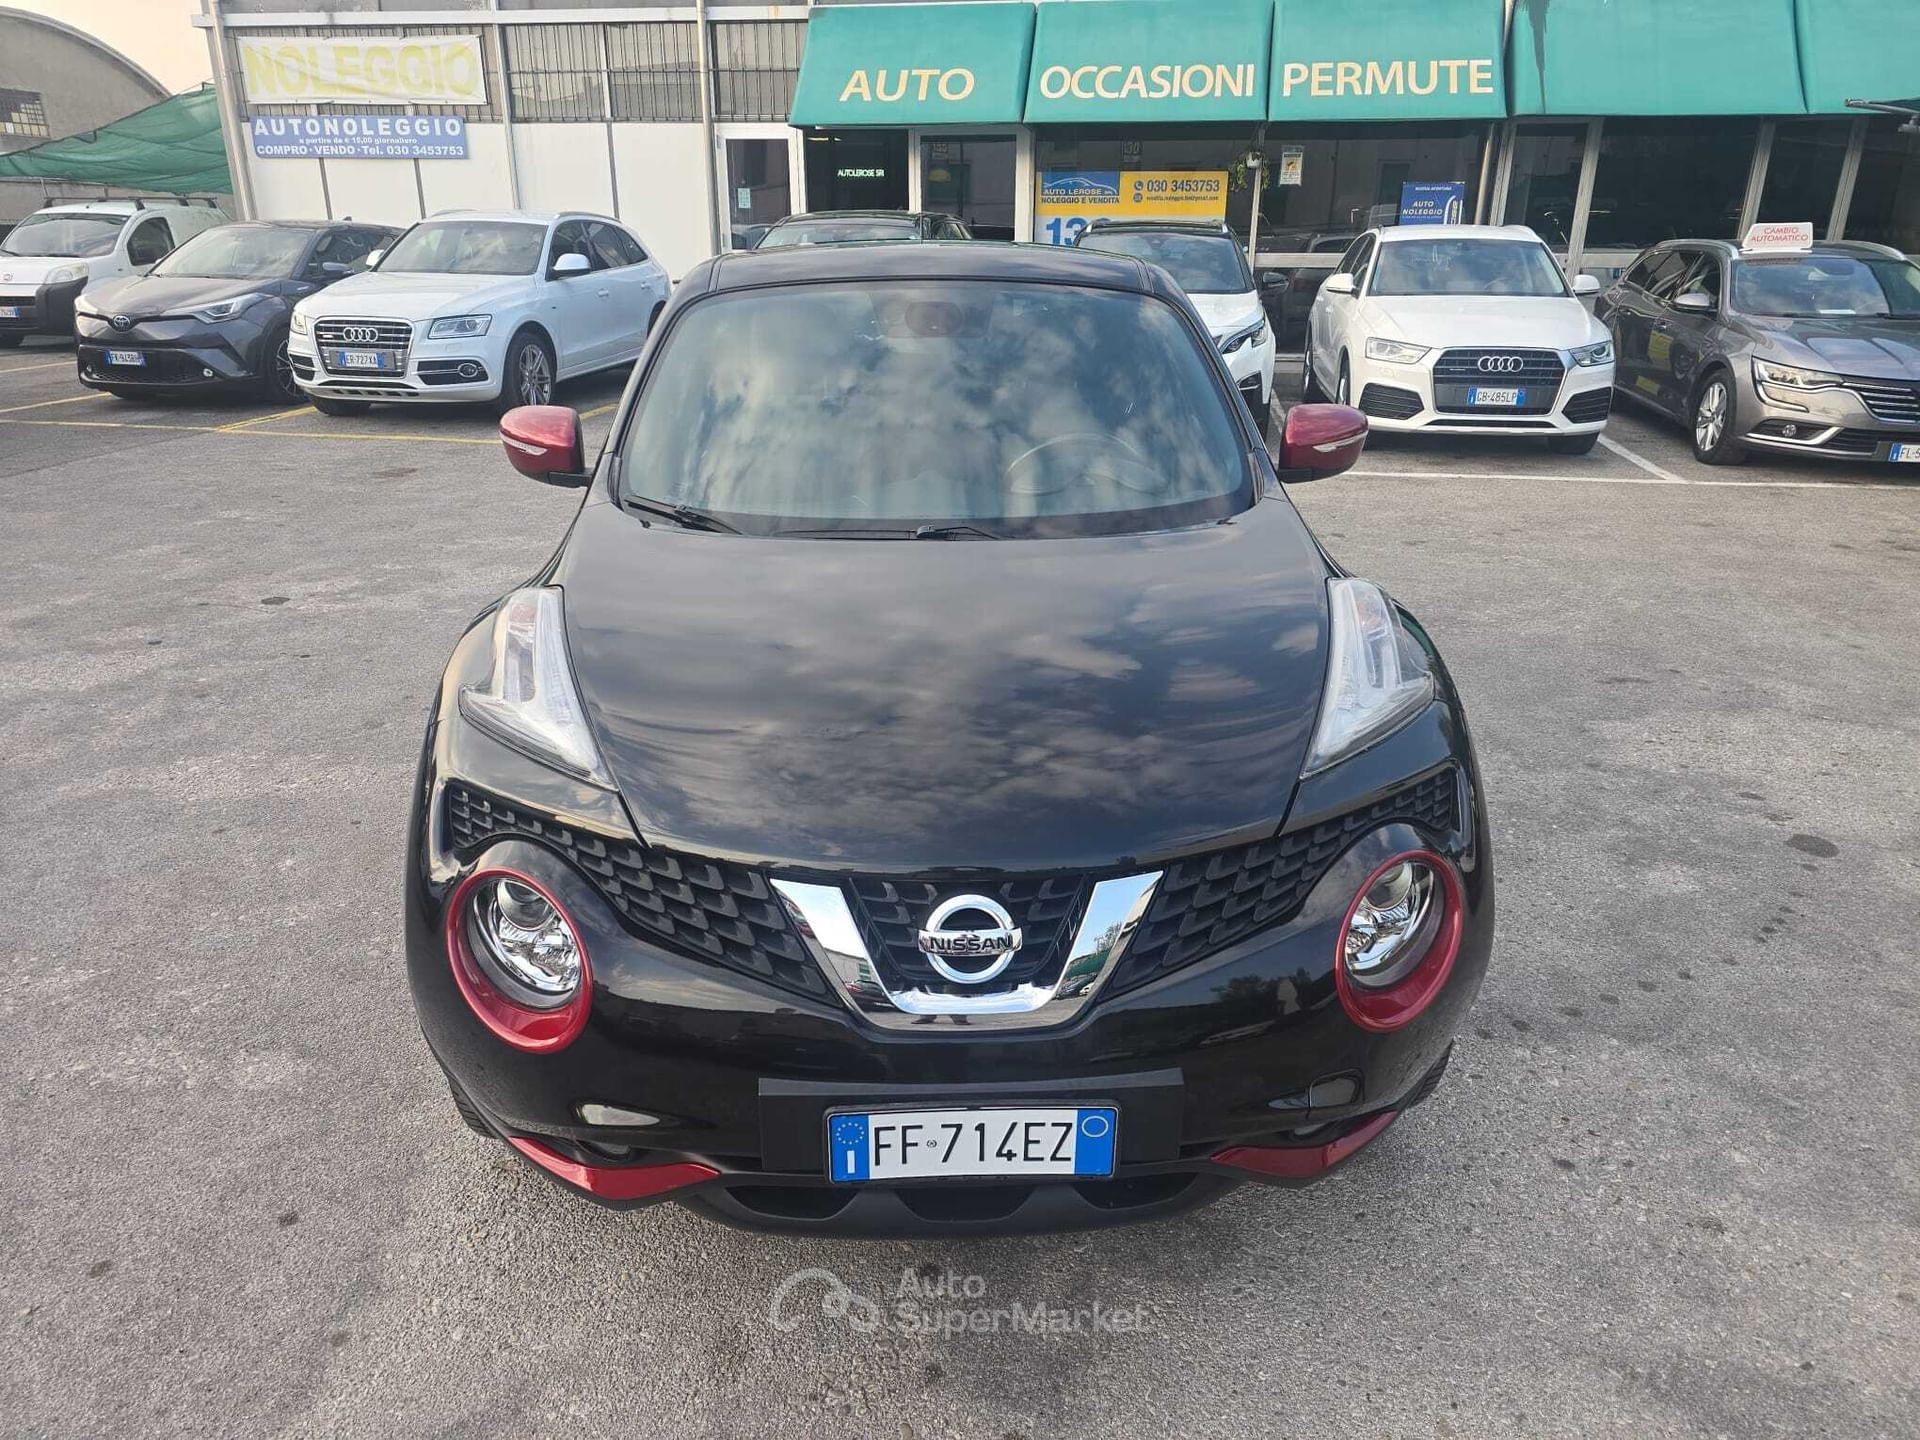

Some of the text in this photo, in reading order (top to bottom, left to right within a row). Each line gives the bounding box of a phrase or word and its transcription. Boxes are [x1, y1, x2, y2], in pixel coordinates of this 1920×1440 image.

[243, 45, 478, 97] NOLEGGIO
[1282, 59, 1494, 97] PERMUTE
[839, 68, 975, 102] AUTO
[1039, 63, 1256, 99] OCCASIONI
[255, 118, 461, 136] AUTONOLEGGIO
[257, 145, 464, 156] COMPRO VENDO Tel. 030 3453753
[1146, 179, 1220, 192] 030 3453753
[1041, 196, 1080, 204] NOLEGGIO
[1088, 196, 1120, 204] VENDITA
[1751, 234, 1809, 242] AUTOMATICO
[929, 935, 1014, 951] NISSAN
